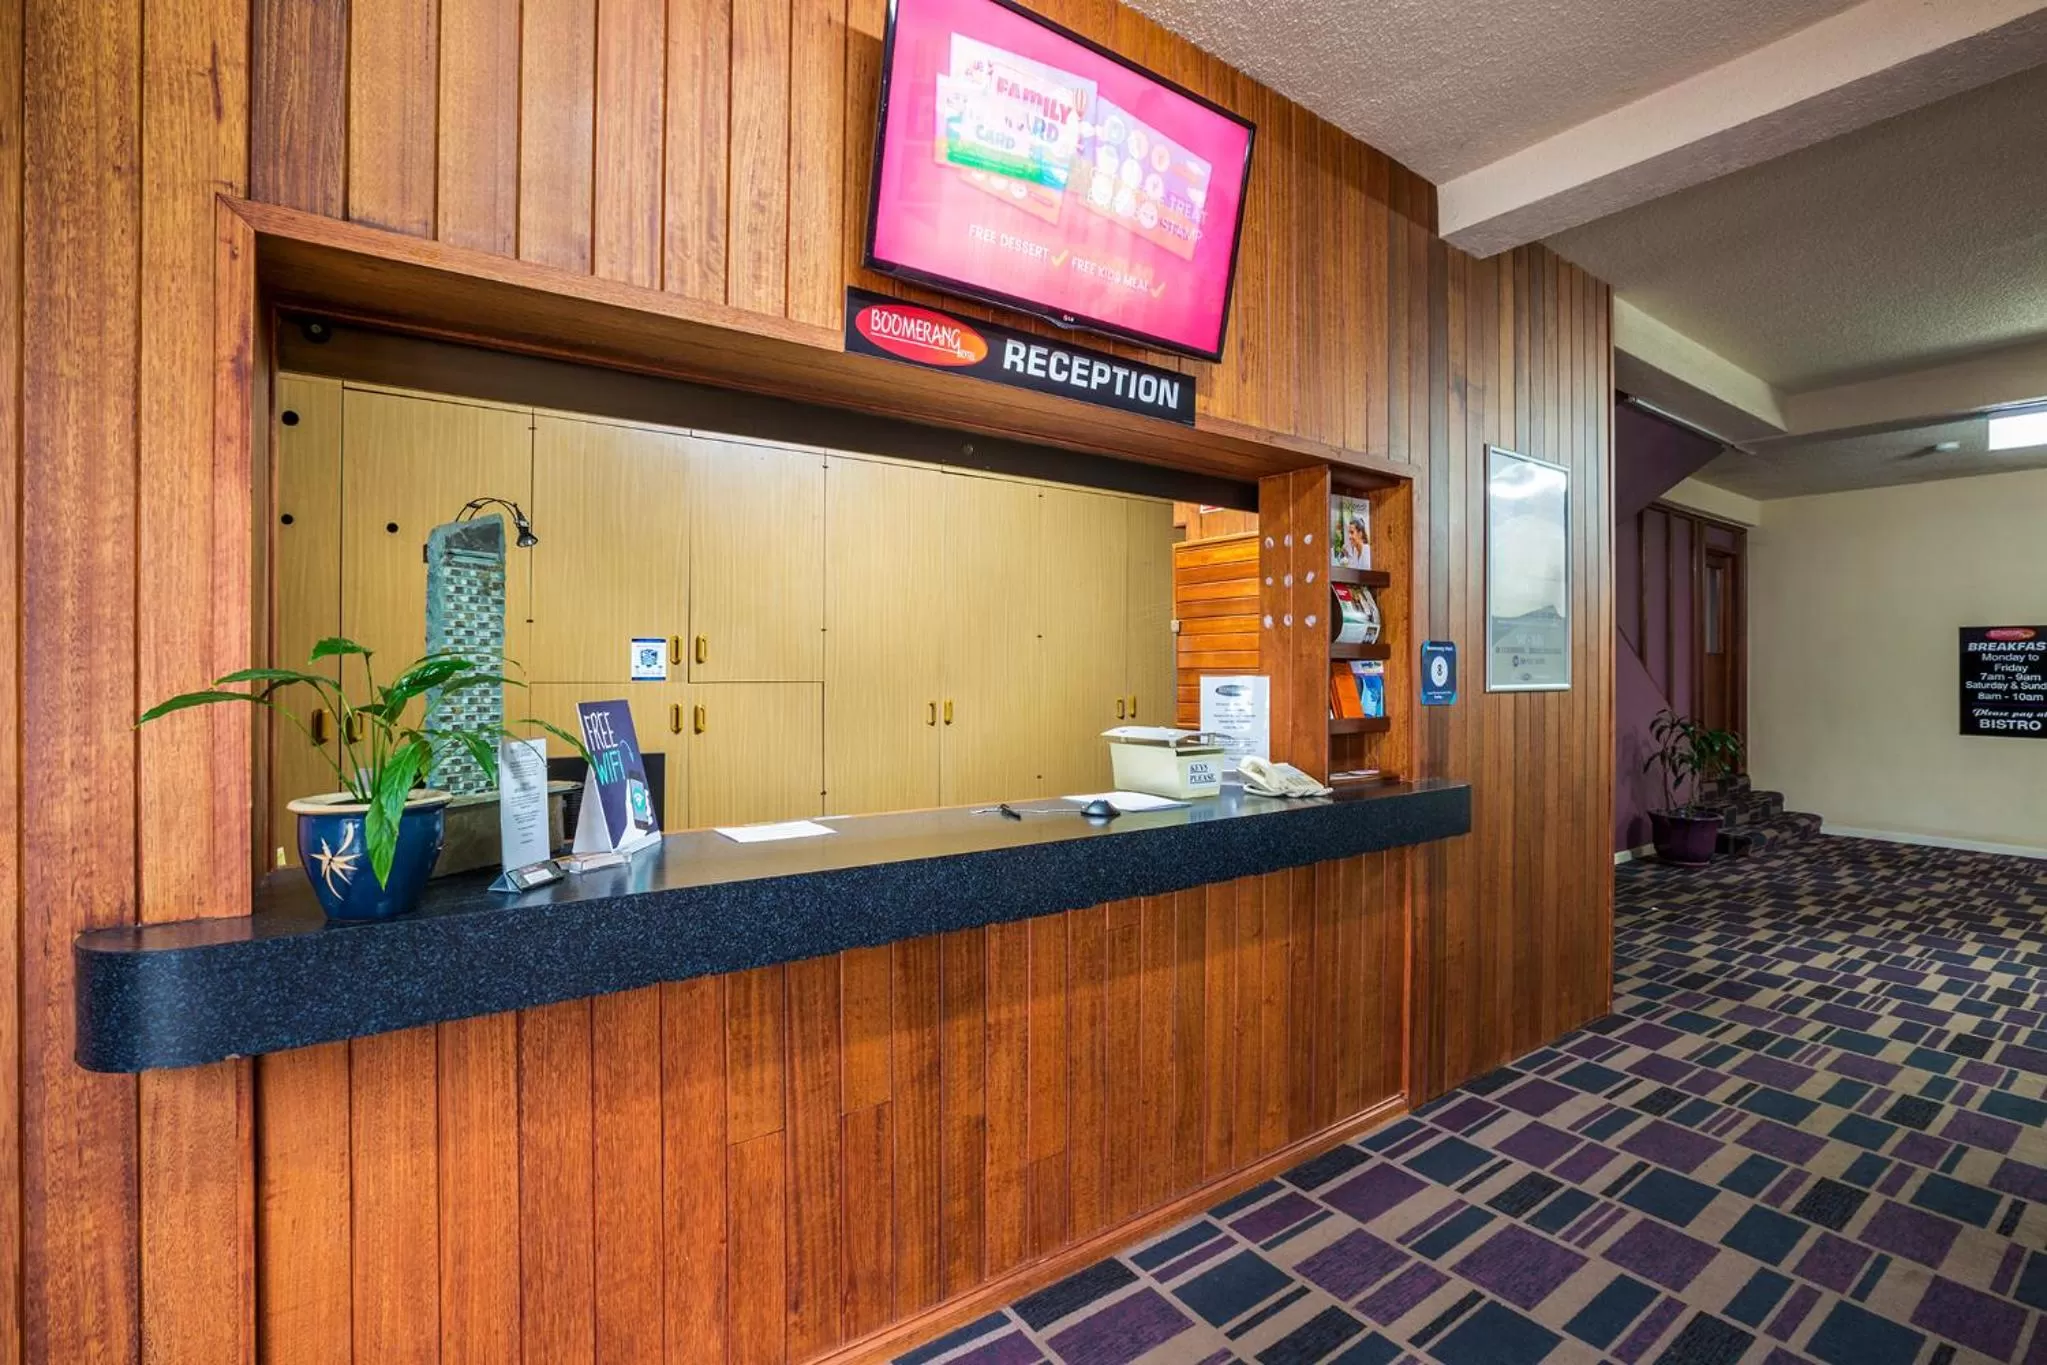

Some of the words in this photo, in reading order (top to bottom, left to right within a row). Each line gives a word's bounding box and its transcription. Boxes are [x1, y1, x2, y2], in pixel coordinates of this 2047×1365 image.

[996, 76, 1072, 125] FAMILY
[968, 224, 997, 244] FREE
[1000, 233, 1050, 262] DESSERT
[1071, 255, 1097, 275] FREE
[870, 307, 961, 354] BOOMERANG
[1003, 338, 1180, 410] RECEPTION
[1981, 653, 2025, 663] Monday
[2028, 653, 2040, 662] to
[1994, 663, 2029, 674] Friday
[1980, 672, 2005, 681] 7am
[2015, 672, 2042, 682] 9am
[1965, 680, 2009, 692] Saturday
[2010, 681, 2019, 690] &
[1978, 692, 2002, 700] 8am
[2012, 693, 2044, 701] 10am
[1972, 708, 2009, 718] Please
[2012, 710, 2034, 719] pay
[1979, 718, 2043, 731] BISTRO
[583, 711, 619, 752] FREE
[593, 749, 626, 786] WIFI
[1190, 763, 1208, 773] KEYS
[1190, 773, 1216, 784] PLEASE
